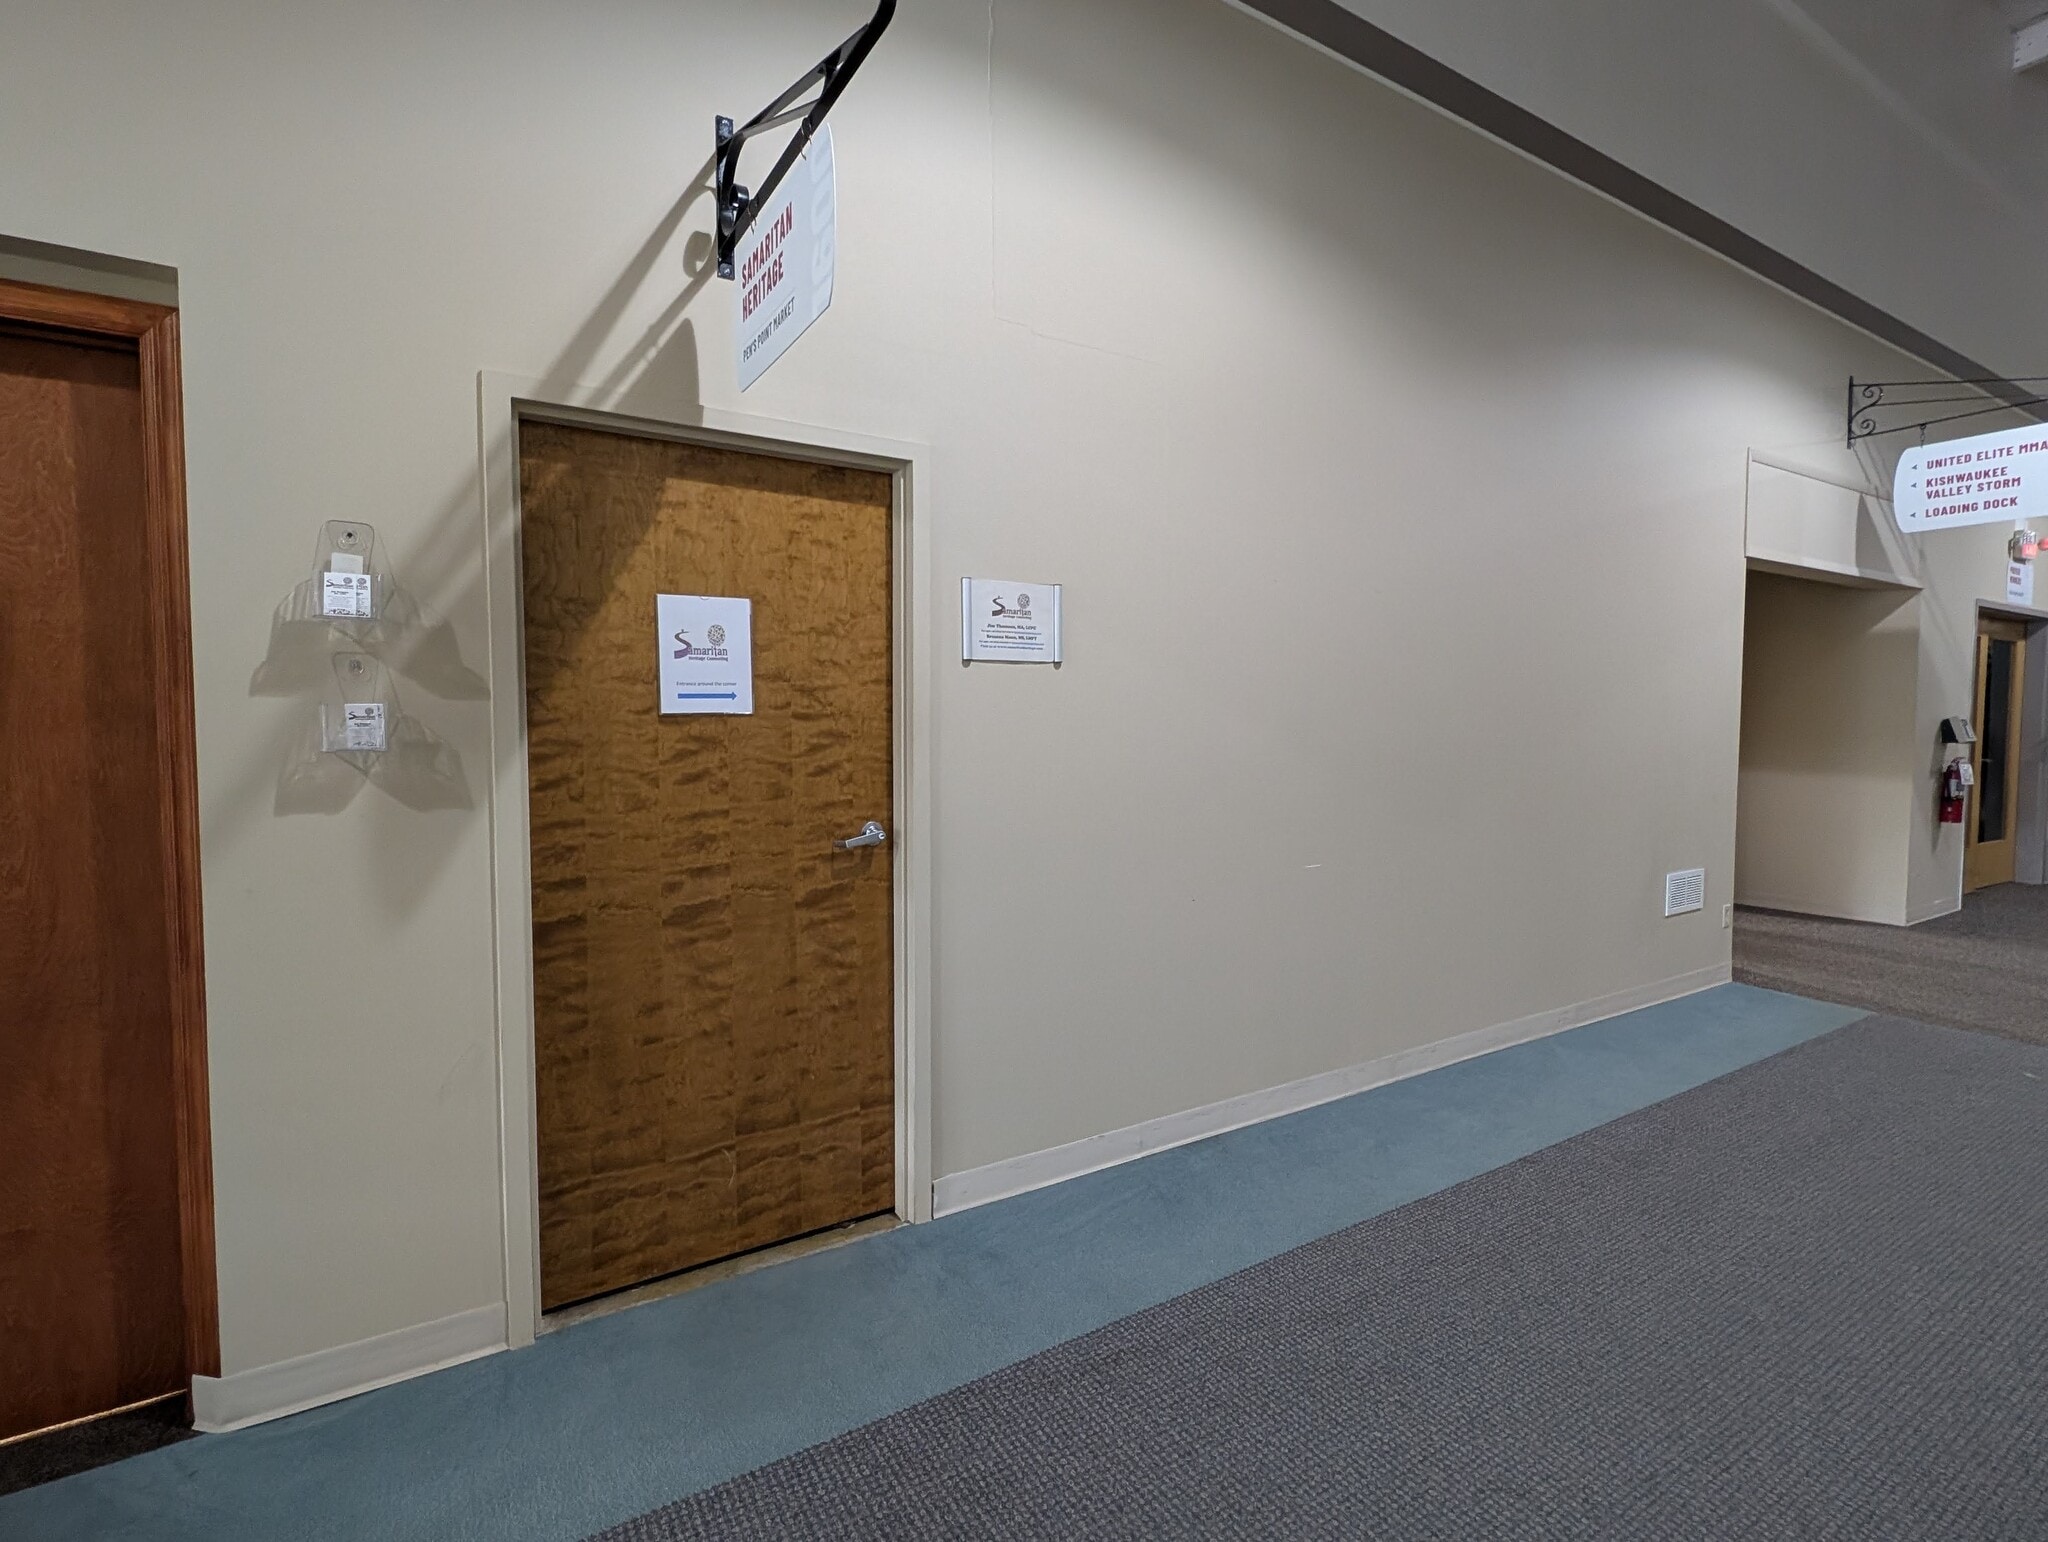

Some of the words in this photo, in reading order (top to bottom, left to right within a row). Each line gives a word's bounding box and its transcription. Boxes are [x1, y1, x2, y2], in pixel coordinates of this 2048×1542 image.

[741, 201, 793, 290] SAMARITAN
[742, 250, 784, 323] HERITAGE
[757, 321, 773, 349] POINT
[773, 296, 795, 332] MARKET
[1926, 454, 1972, 470] UNITED
[1976, 446, 2014, 462] ELITE
[2019, 440, 2048, 454] MMA
[1926, 466, 2009, 488] KISHWAUKEE
[1926, 484, 1972, 500] VALLEY
[1976, 476, 2021, 492] STORM
[1925, 502, 1979, 518] LOADING
[1983, 496, 2018, 511] DOCK
[992, 596, 1031, 616] Samaritan
[674, 629, 728, 659] Samaritan
